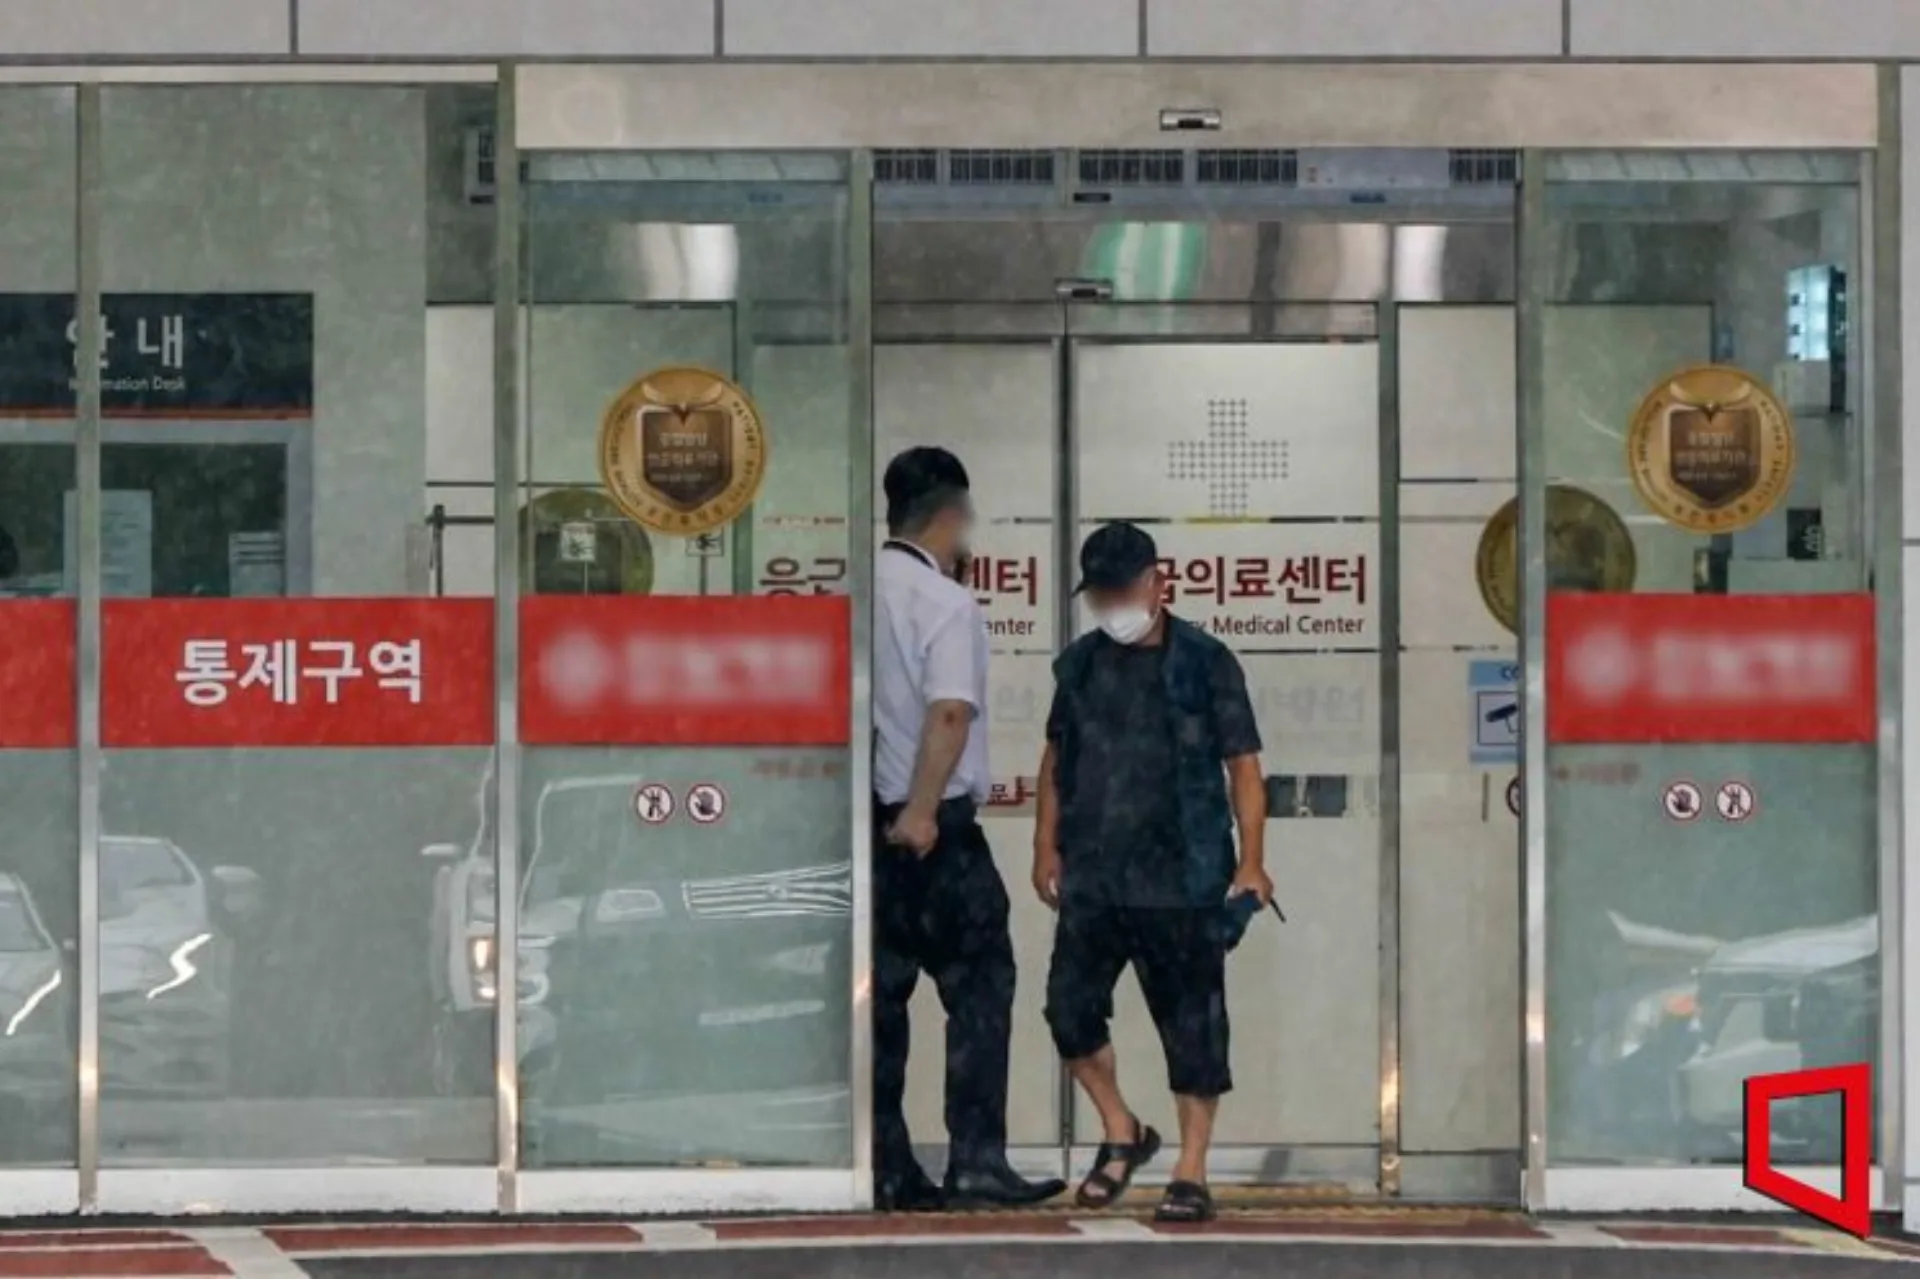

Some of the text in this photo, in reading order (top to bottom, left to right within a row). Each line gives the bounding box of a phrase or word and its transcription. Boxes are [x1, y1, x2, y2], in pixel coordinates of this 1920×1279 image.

[1157, 554, 1366, 606] 급의료센터
[984, 618, 1035, 636] enter
[1213, 614, 1290, 635] Medical
[1297, 616, 1365, 635] Center
[175, 639, 421, 705] 통제구역
